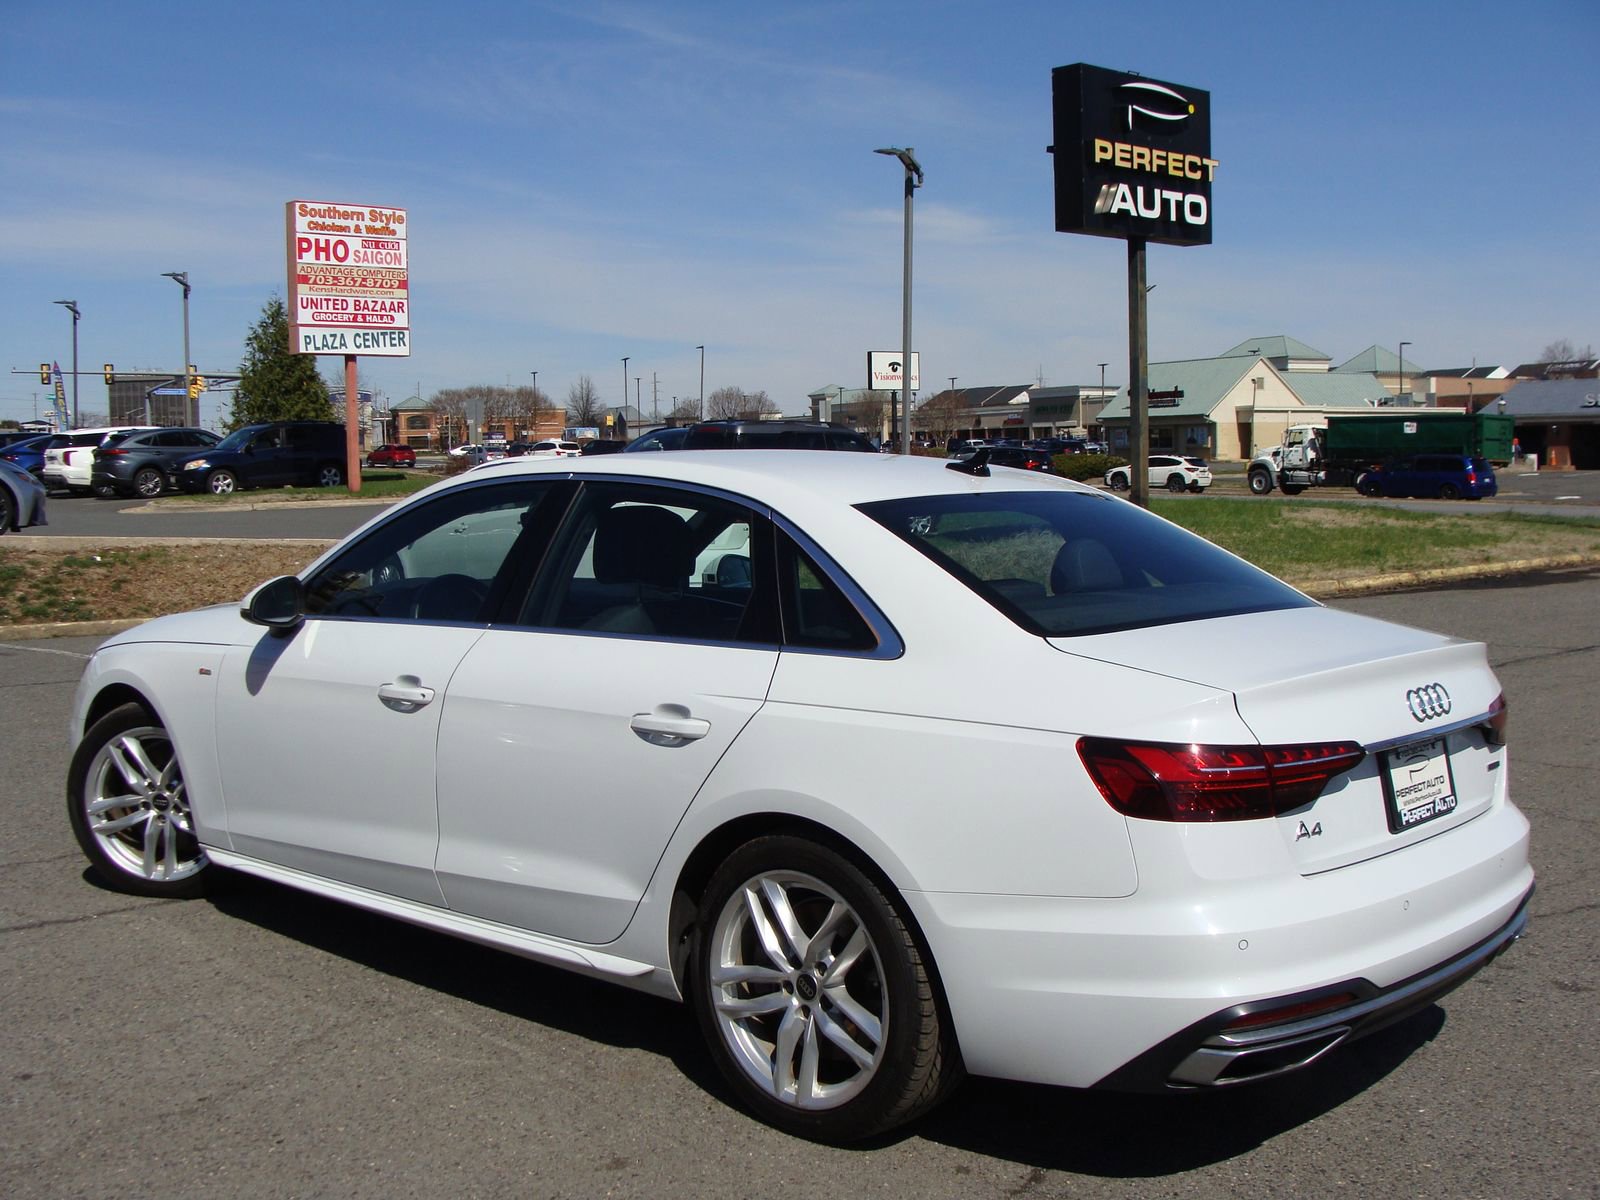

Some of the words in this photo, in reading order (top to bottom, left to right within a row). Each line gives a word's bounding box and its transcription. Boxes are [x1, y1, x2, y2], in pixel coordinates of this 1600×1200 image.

[1094, 138, 1219, 182] PERFECT
[1110, 183, 1208, 225] AUTO
[298, 203, 365, 222] Southern
[369, 209, 405, 226] Style
[307, 220, 351, 234] Chicken
[354, 224, 362, 234] &
[297, 237, 350, 263] PHO
[353, 250, 402, 266] SAIGON
[299, 266, 355, 277] ADVANTAGE
[356, 268, 406, 279] COMPUTERS
[308, 275, 399, 289] 703-367-8709
[309, 285, 394, 297] KensHardware.com
[300, 297, 349, 311] UNITED
[354, 299, 405, 313] BAZAAR
[313, 312, 354, 322] GROCERY
[357, 313, 363, 322] &
[366, 314, 393, 323] HALAL
[304, 333, 348, 352] PLAZA
[353, 331, 406, 349] CENTER
[1295, 820, 1323, 842] A4
